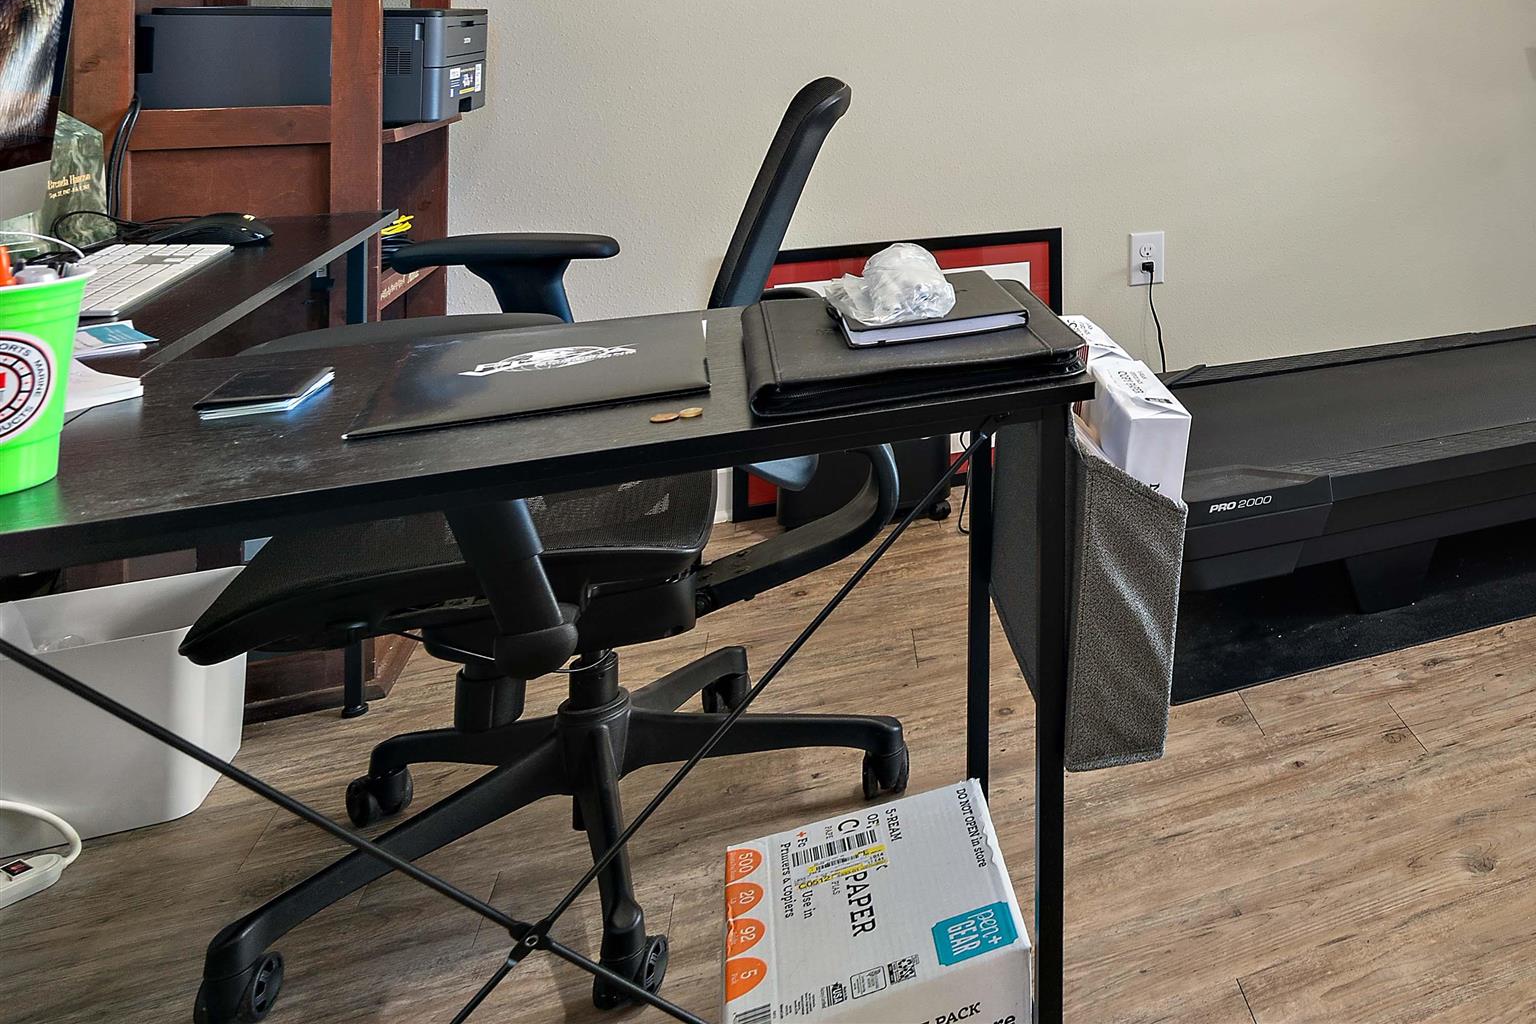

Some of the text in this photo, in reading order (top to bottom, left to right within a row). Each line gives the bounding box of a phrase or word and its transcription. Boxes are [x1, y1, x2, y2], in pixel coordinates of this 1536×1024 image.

[0, 342, 32, 357] ORTS
[1208, 495, 1273, 514] PRO 2000
[956, 787, 987, 868] DO NOT OPEN in store
[739, 852, 753, 873] 500
[739, 889, 755, 904] 20
[780, 883, 797, 919] Copiers
[801, 890, 814, 908] Use
[845, 870, 877, 937] PAPER
[803, 907, 816, 920] in
[740, 925, 756, 943] 92
[947, 917, 981, 957] GEAR
[740, 968, 758, 980] 5
